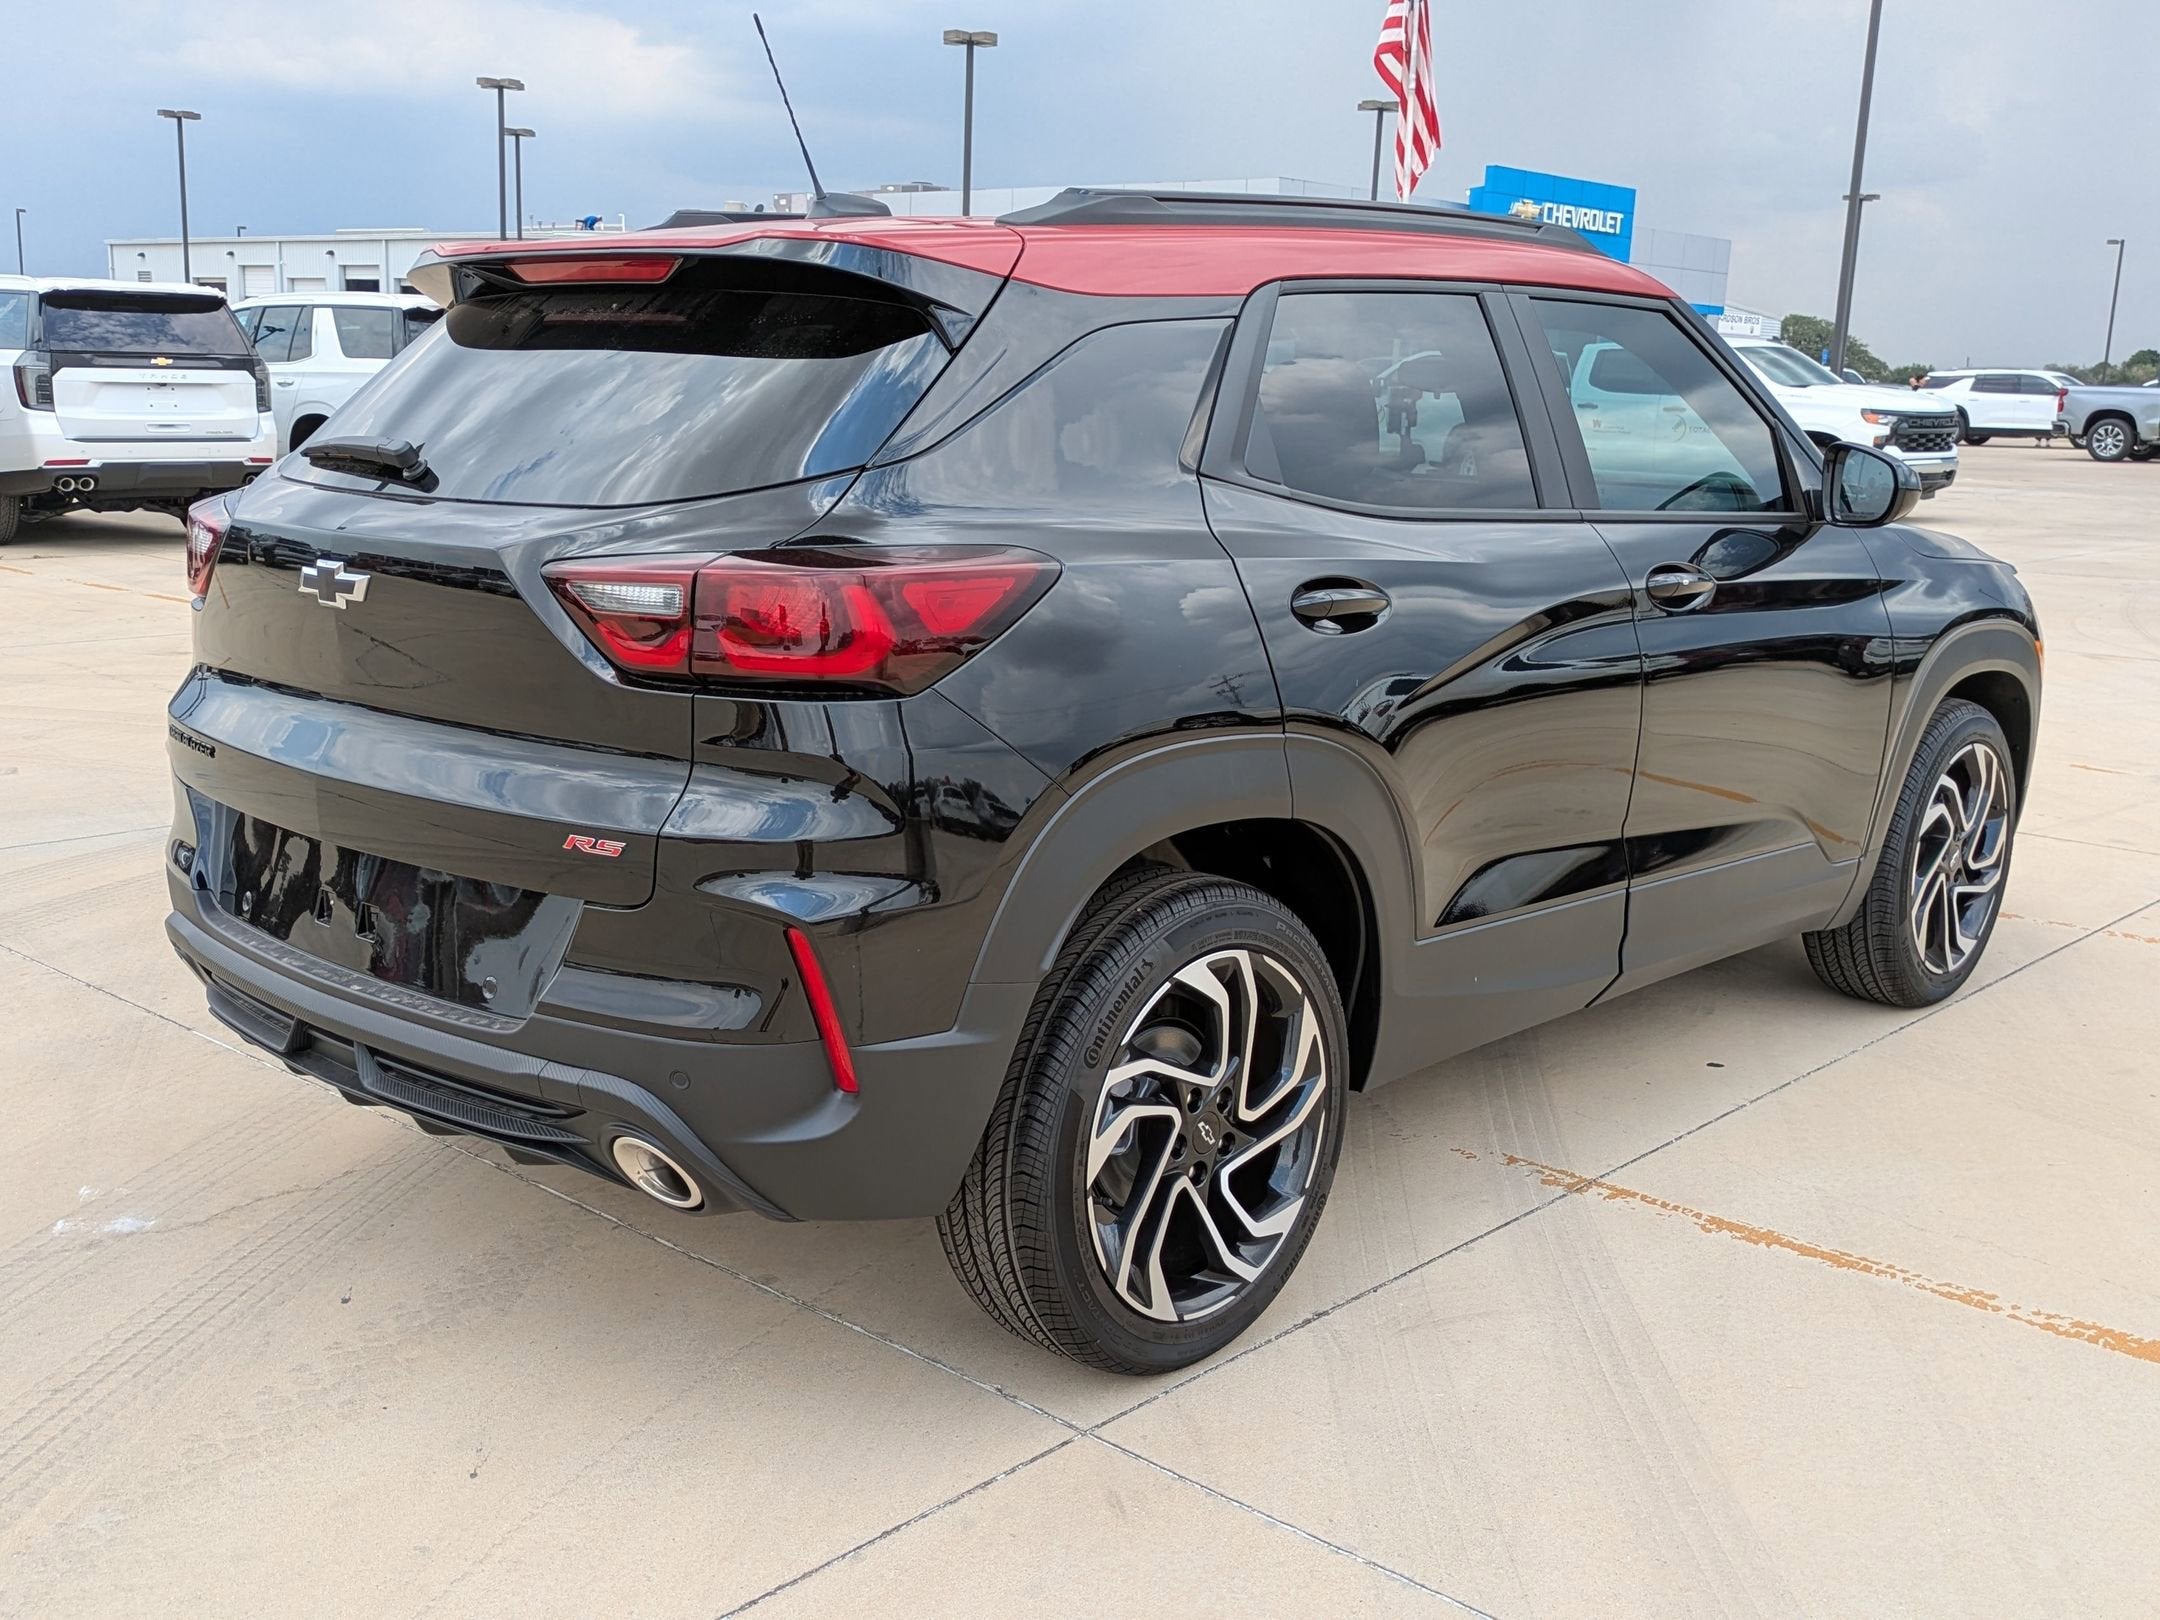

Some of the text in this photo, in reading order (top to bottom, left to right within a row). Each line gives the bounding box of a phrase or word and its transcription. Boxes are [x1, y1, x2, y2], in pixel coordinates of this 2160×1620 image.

[1543, 202, 1624, 234] CHEVROLET
[1909, 418, 1958, 428] CHEVROL
[562, 834, 627, 857] RS
